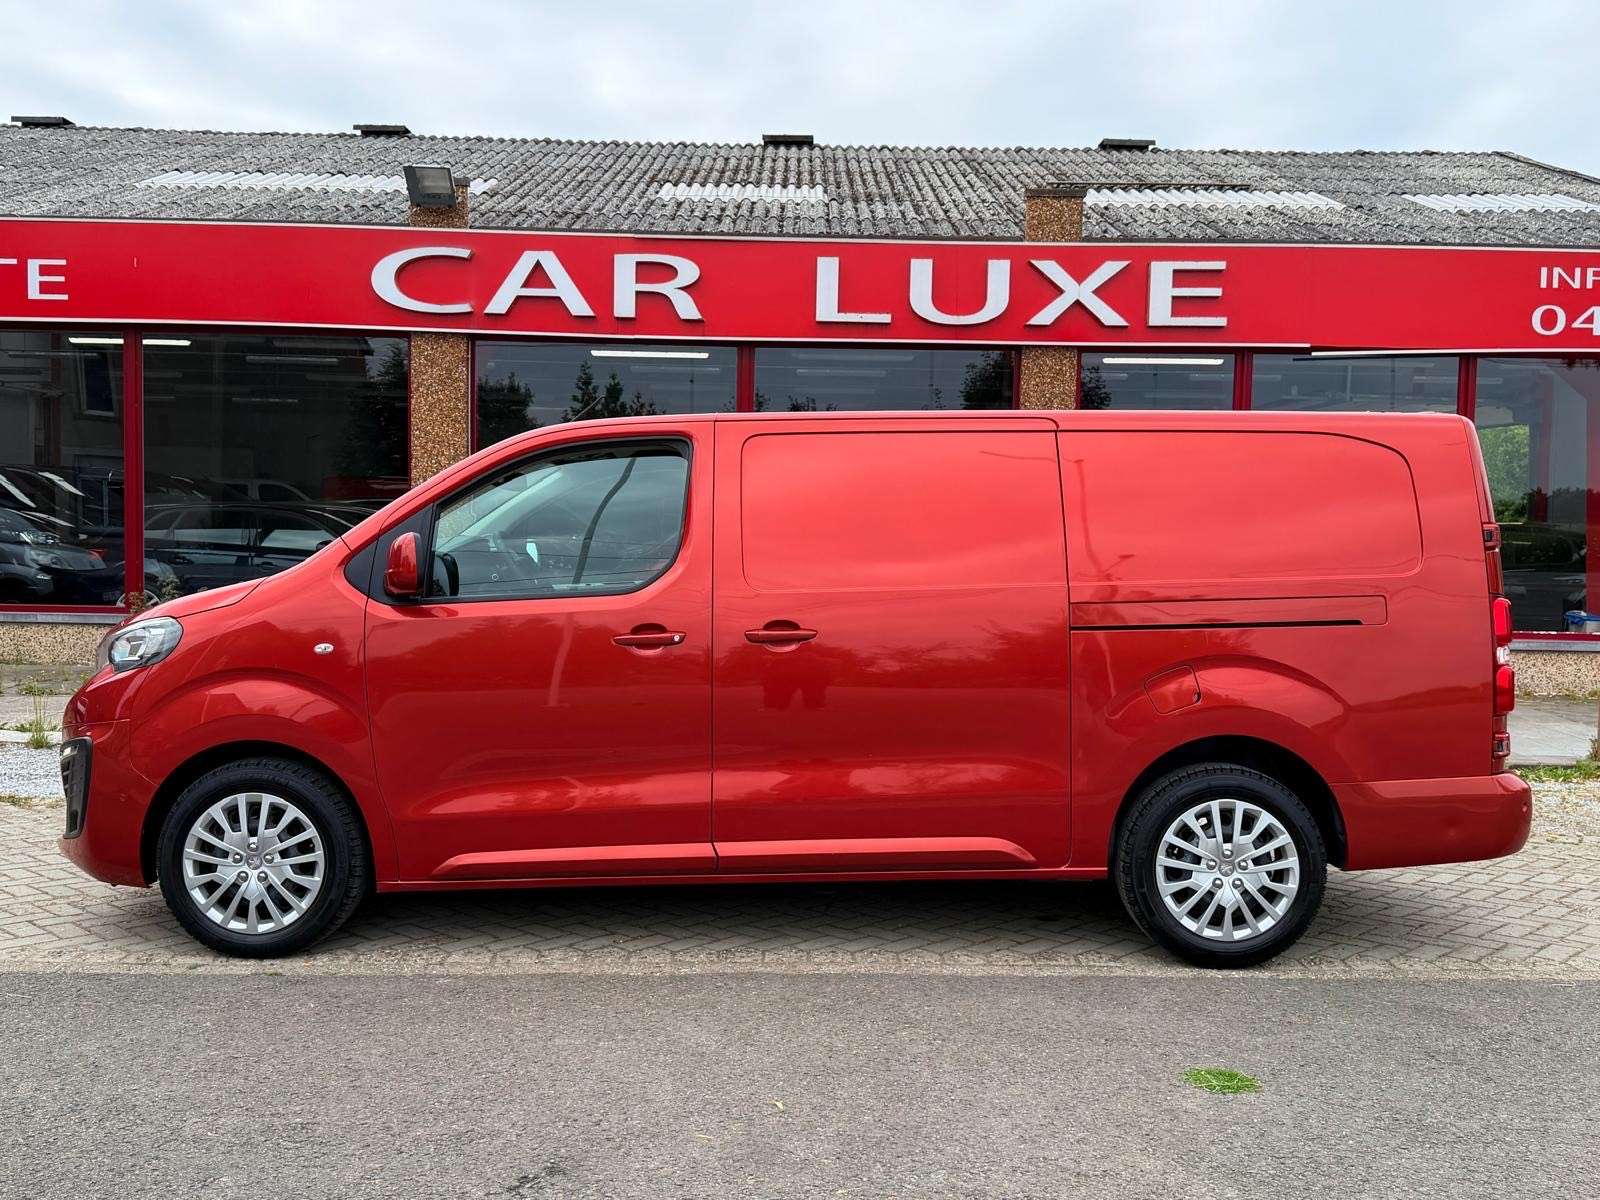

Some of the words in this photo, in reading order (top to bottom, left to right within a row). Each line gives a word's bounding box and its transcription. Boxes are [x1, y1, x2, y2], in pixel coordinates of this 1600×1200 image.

[371, 247, 703, 320] CAR
[815, 257, 1228, 327] LUXE
[1531, 304, 1600, 336] 04
